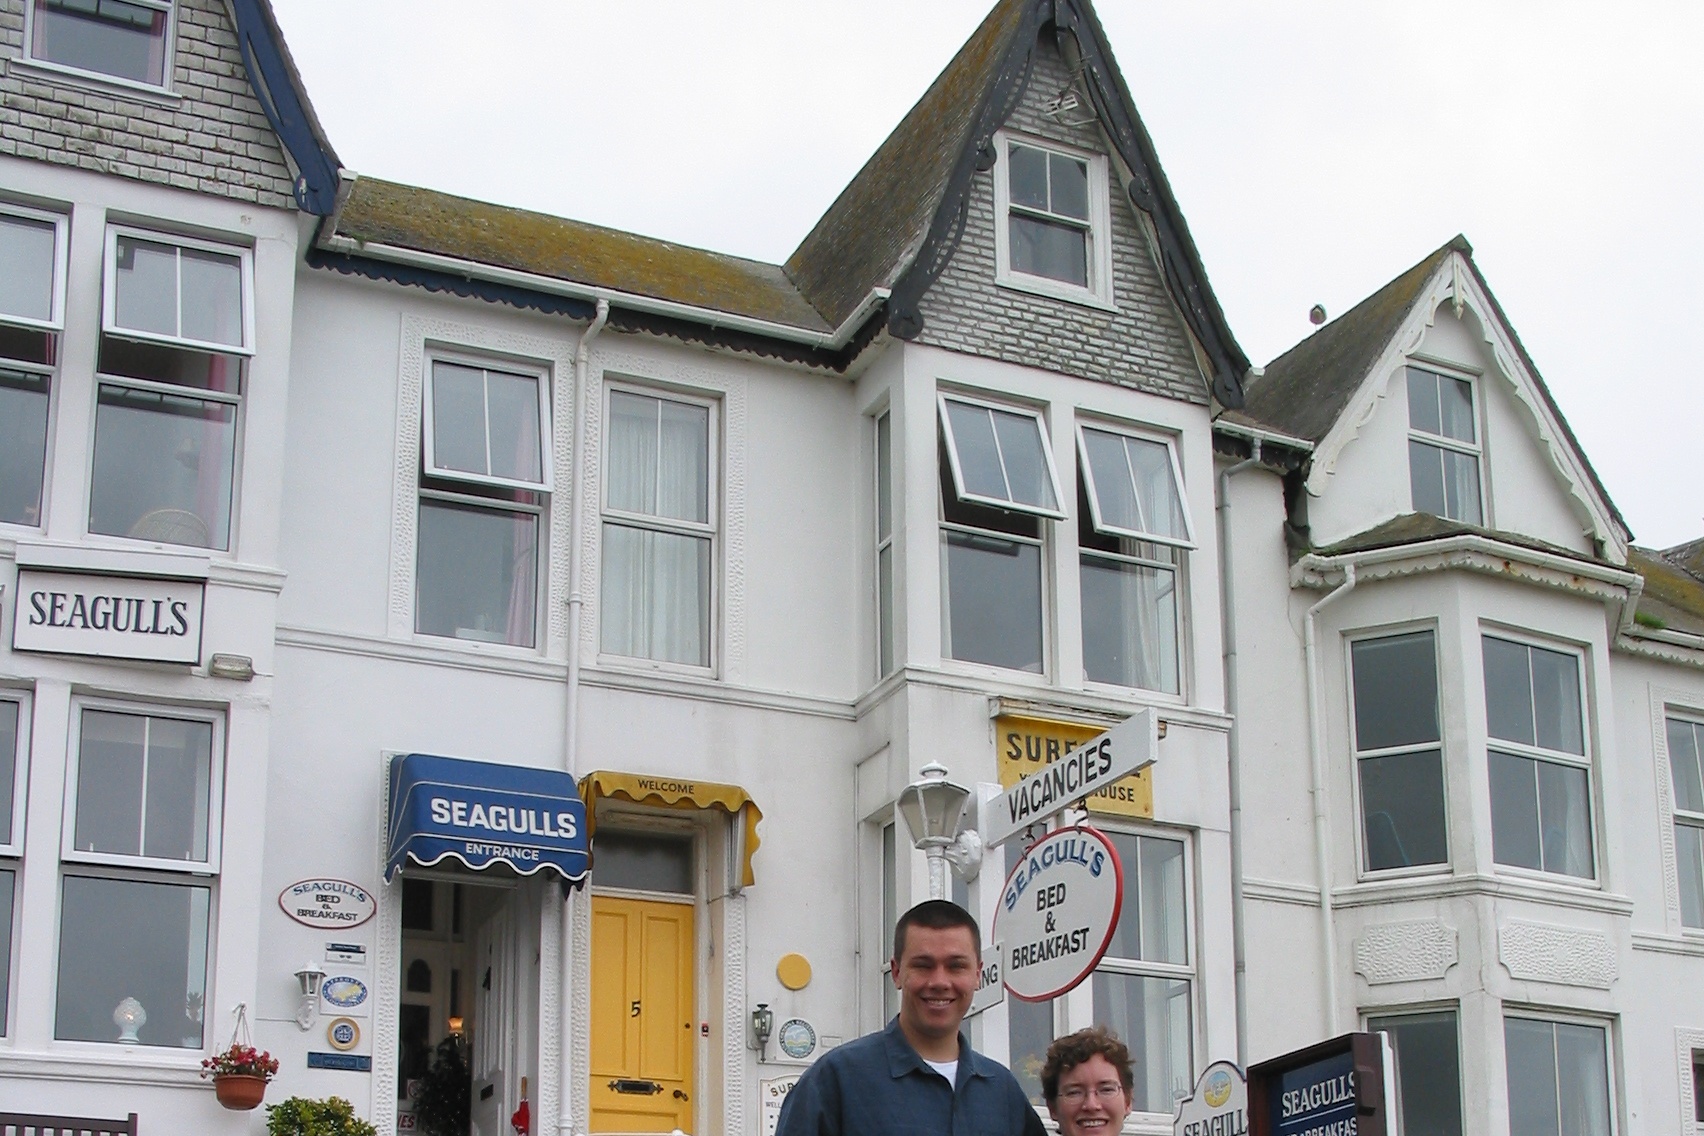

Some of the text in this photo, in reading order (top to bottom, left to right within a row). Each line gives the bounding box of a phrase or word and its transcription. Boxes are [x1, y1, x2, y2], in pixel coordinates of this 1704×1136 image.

[29, 591, 188, 636] SEAGULL'S
[637, 779, 695, 795] WELCOME
[1008, 738, 1111, 824] VACANCIES
[430, 797, 577, 839] SEAGULLS
[466, 842, 539, 861] ENTRANCE
[1004, 838, 1105, 912] SEAGULL'S
[292, 882, 367, 903] SEAGULL'S
[316, 894, 341, 904] BED
[1036, 882, 1066, 911] BED
[297, 908, 358, 921] BREAKFAST
[1044, 911, 1056, 933] &
[1011, 927, 1090, 971] BREAKFAST
[631, 1001, 641, 1017] 5
